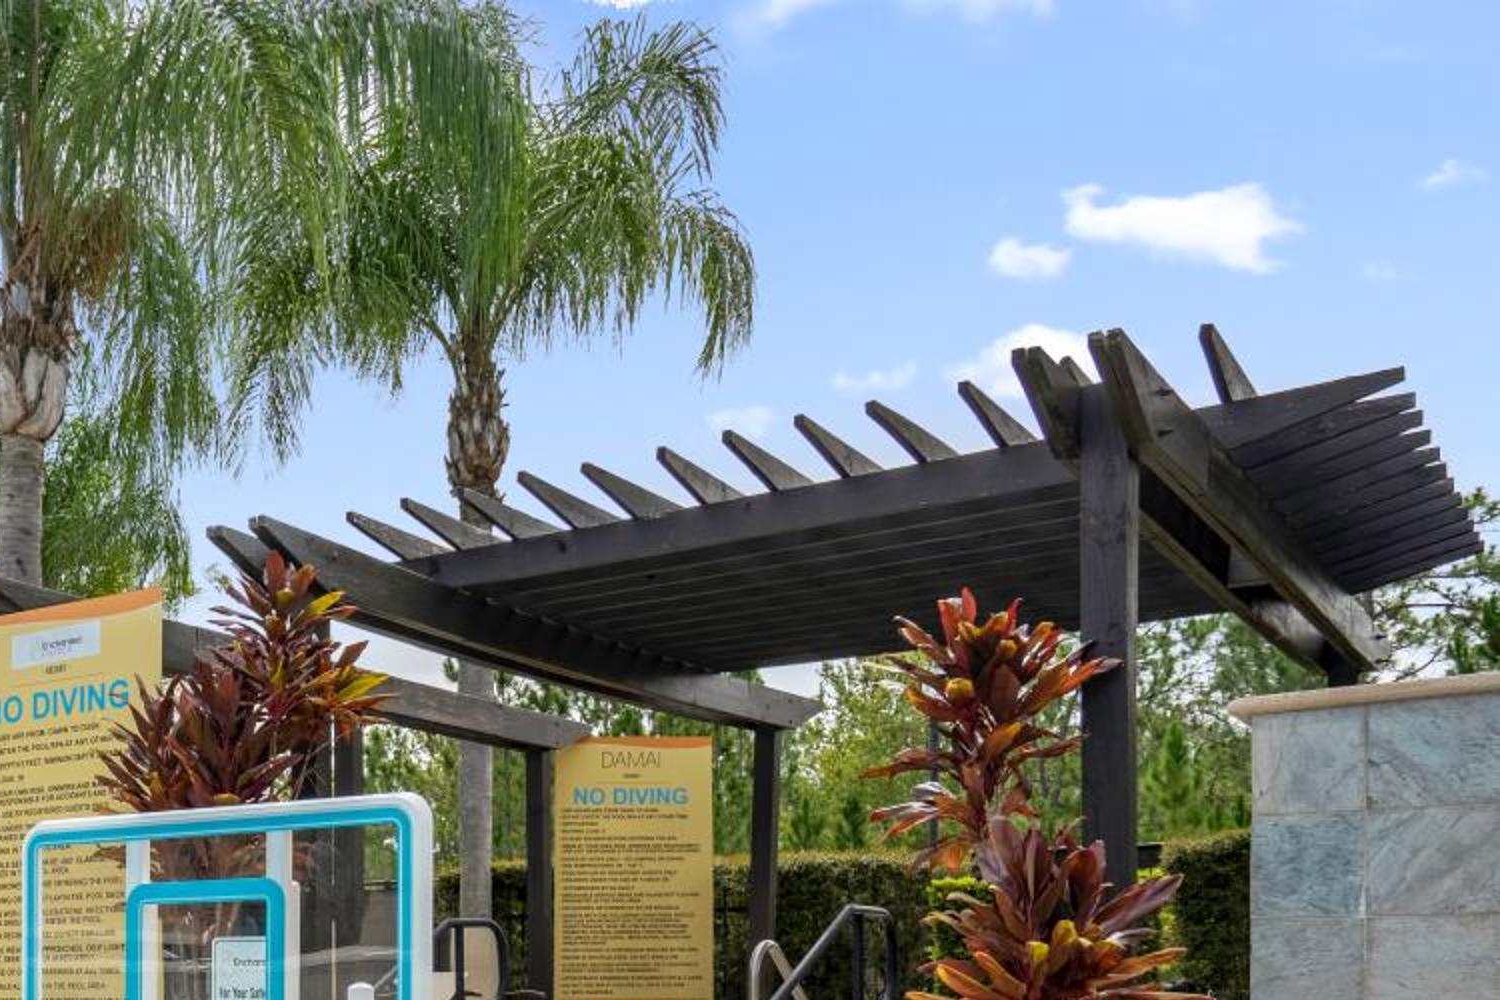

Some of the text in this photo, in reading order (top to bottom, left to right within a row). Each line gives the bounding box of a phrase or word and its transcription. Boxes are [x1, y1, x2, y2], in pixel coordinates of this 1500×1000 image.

[32, 679, 129, 720] DIVING
[601, 751, 661, 769] DAMAI
[574, 786, 690, 805] NO DIVING
